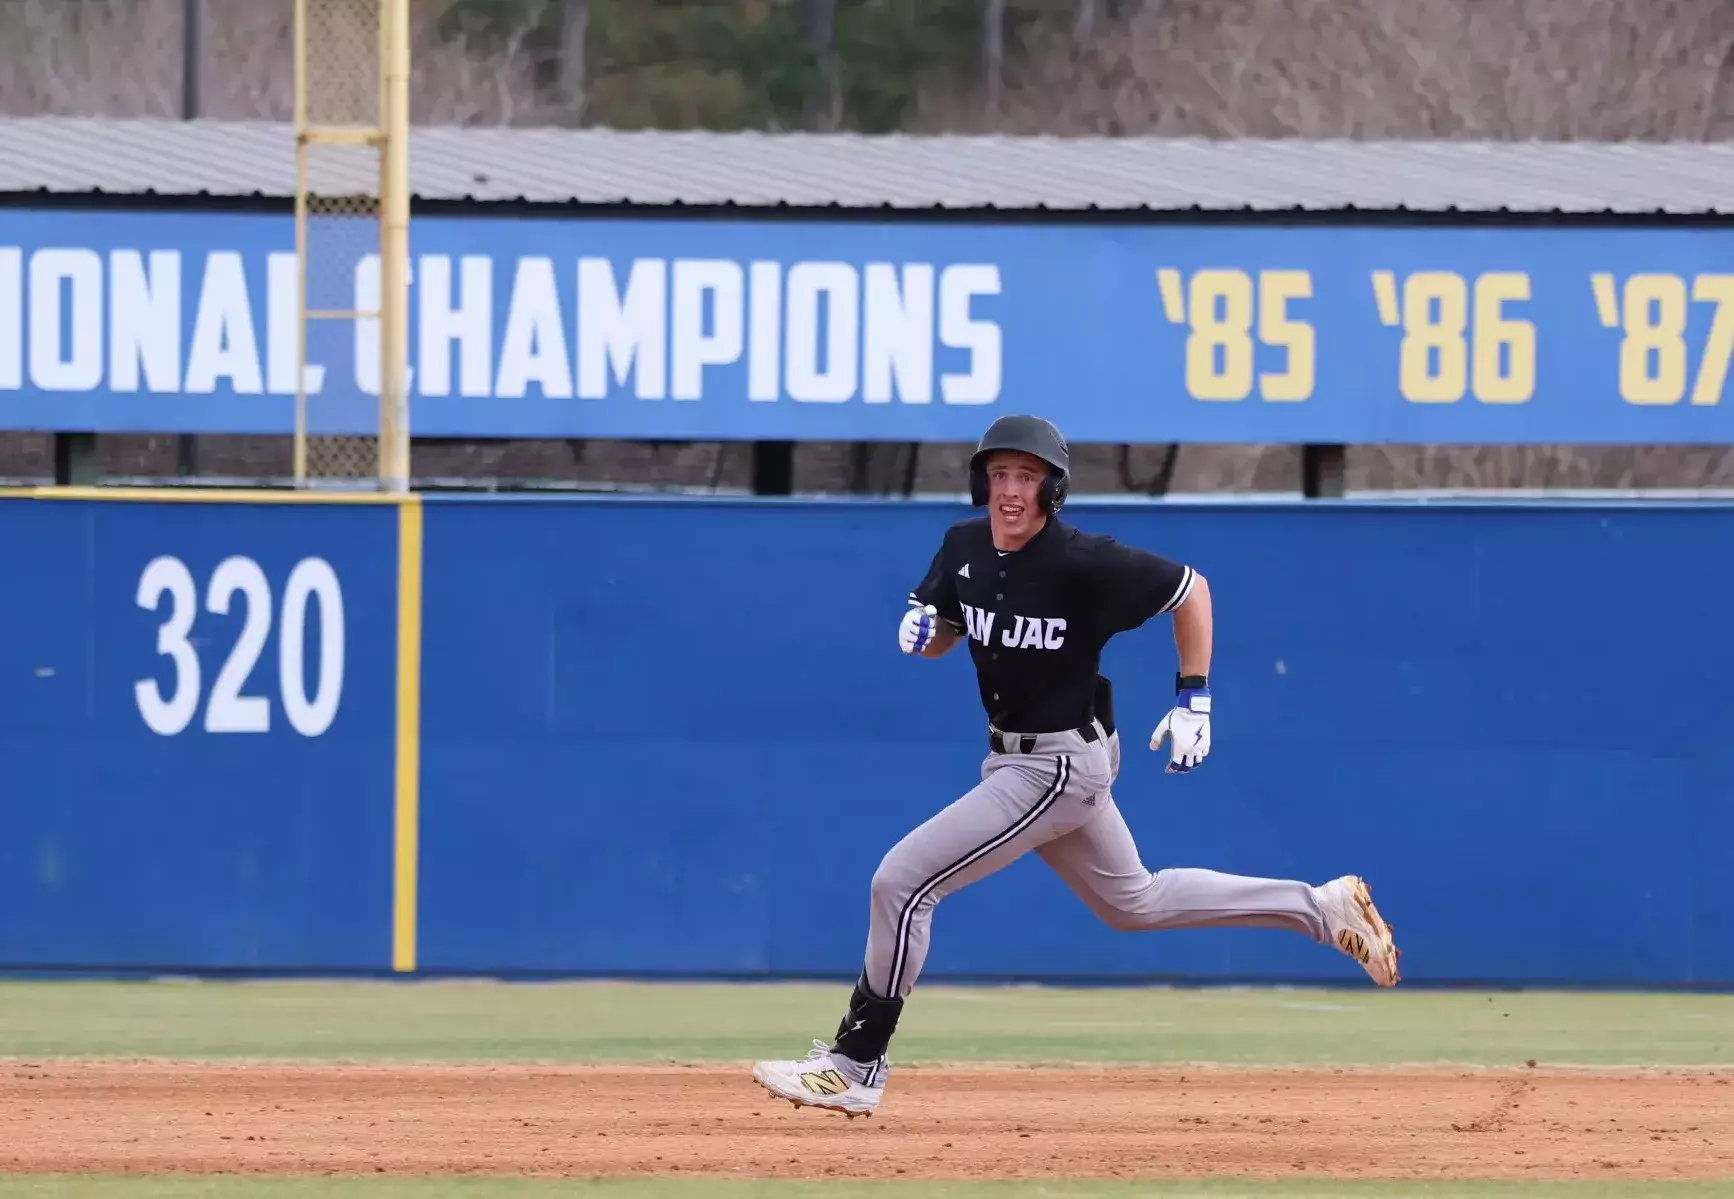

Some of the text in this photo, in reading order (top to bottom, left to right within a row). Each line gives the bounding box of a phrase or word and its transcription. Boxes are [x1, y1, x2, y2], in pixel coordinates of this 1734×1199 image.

[0, 246, 325, 394] IONAL
[1156, 268, 1316, 402] '85
[1370, 270, 1536, 404] '86
[1590, 273, 1734, 406] '87
[134, 554, 345, 737] 320
[959, 600, 1067, 650] AN JAC
